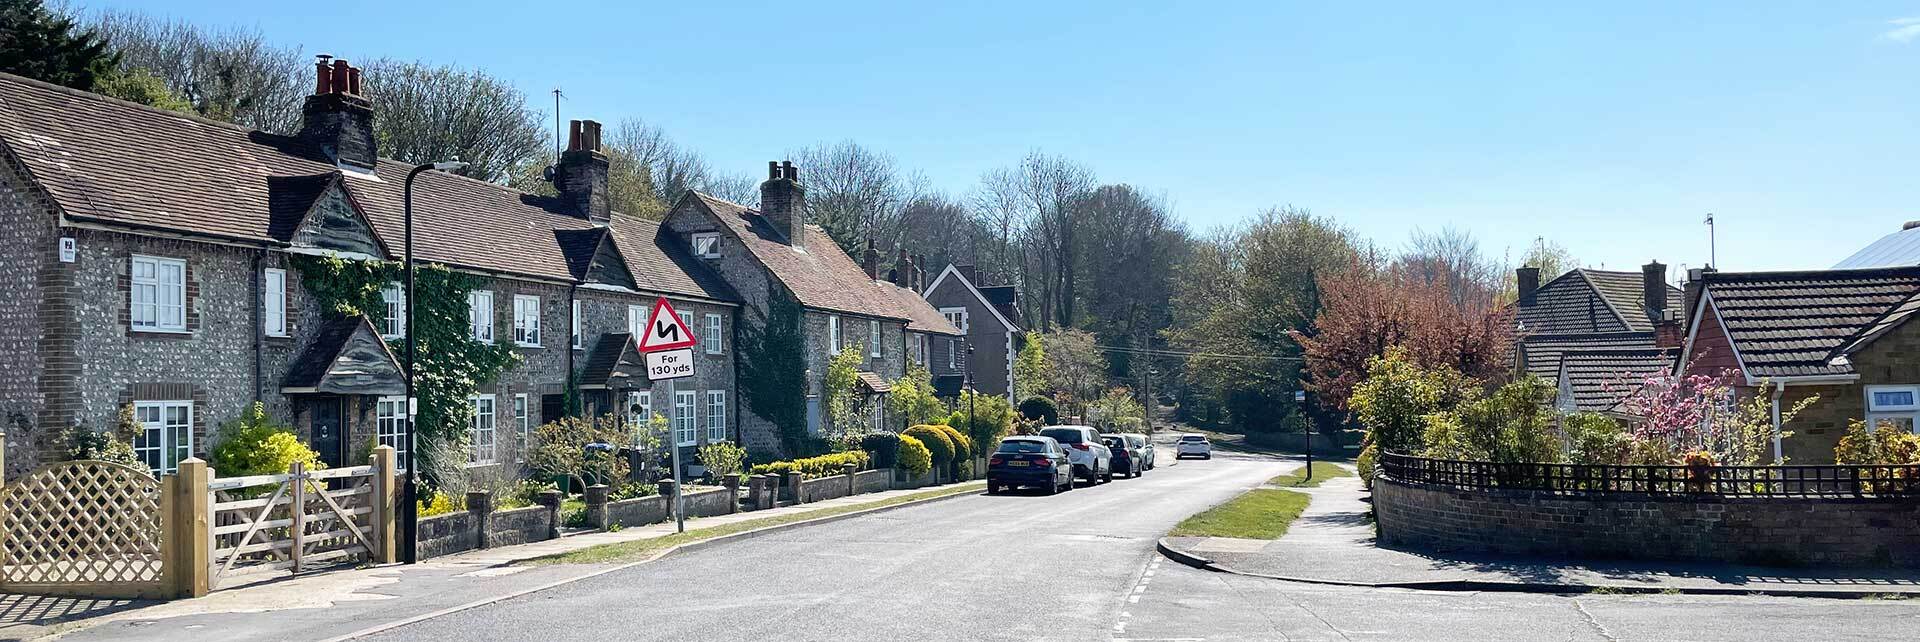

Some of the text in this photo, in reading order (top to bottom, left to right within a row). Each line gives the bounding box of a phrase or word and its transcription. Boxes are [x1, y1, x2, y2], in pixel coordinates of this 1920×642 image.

[661, 355, 678, 363] For
[652, 364, 690, 375] 130 yds
